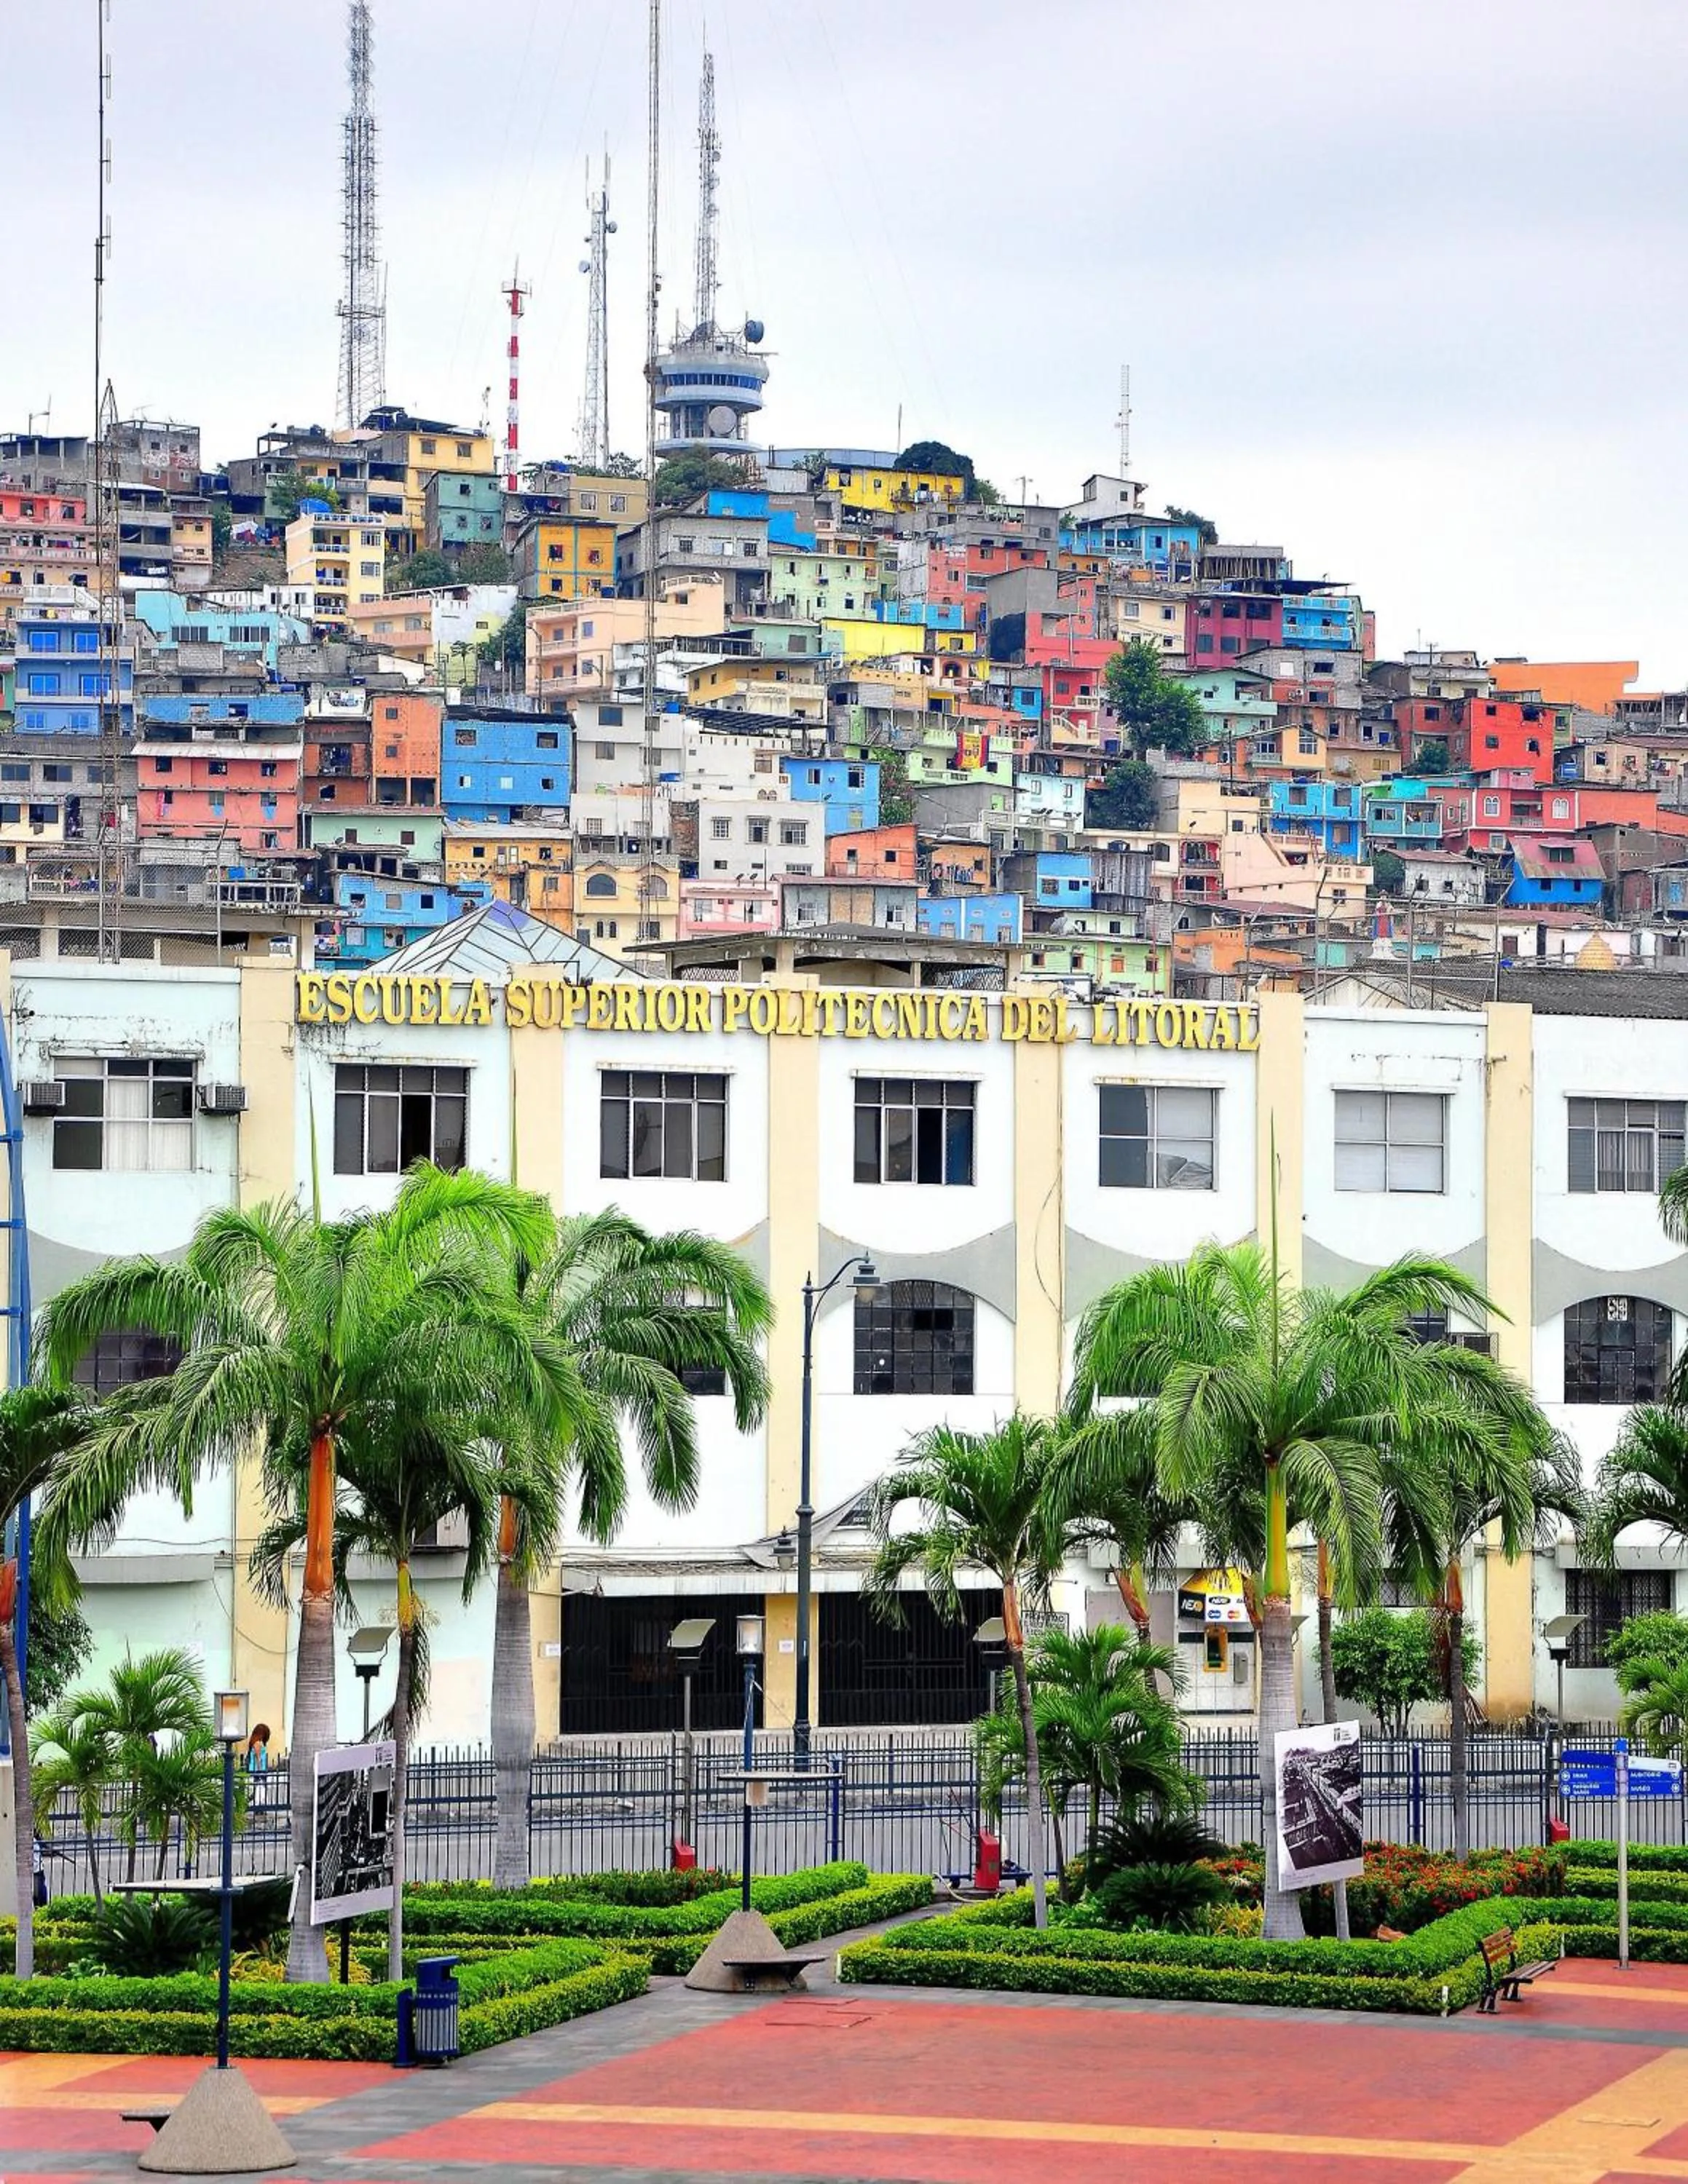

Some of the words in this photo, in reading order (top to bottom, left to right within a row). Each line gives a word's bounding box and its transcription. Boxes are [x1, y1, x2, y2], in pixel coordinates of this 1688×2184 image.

[297, 973, 493, 1025] ESCUELA
[505, 978, 712, 1032] SUPERIOR
[722, 986, 989, 1040] POLITECNICA
[1001, 995, 1078, 1044] DEL
[1091, 1000, 1262, 1051] LITORAL
